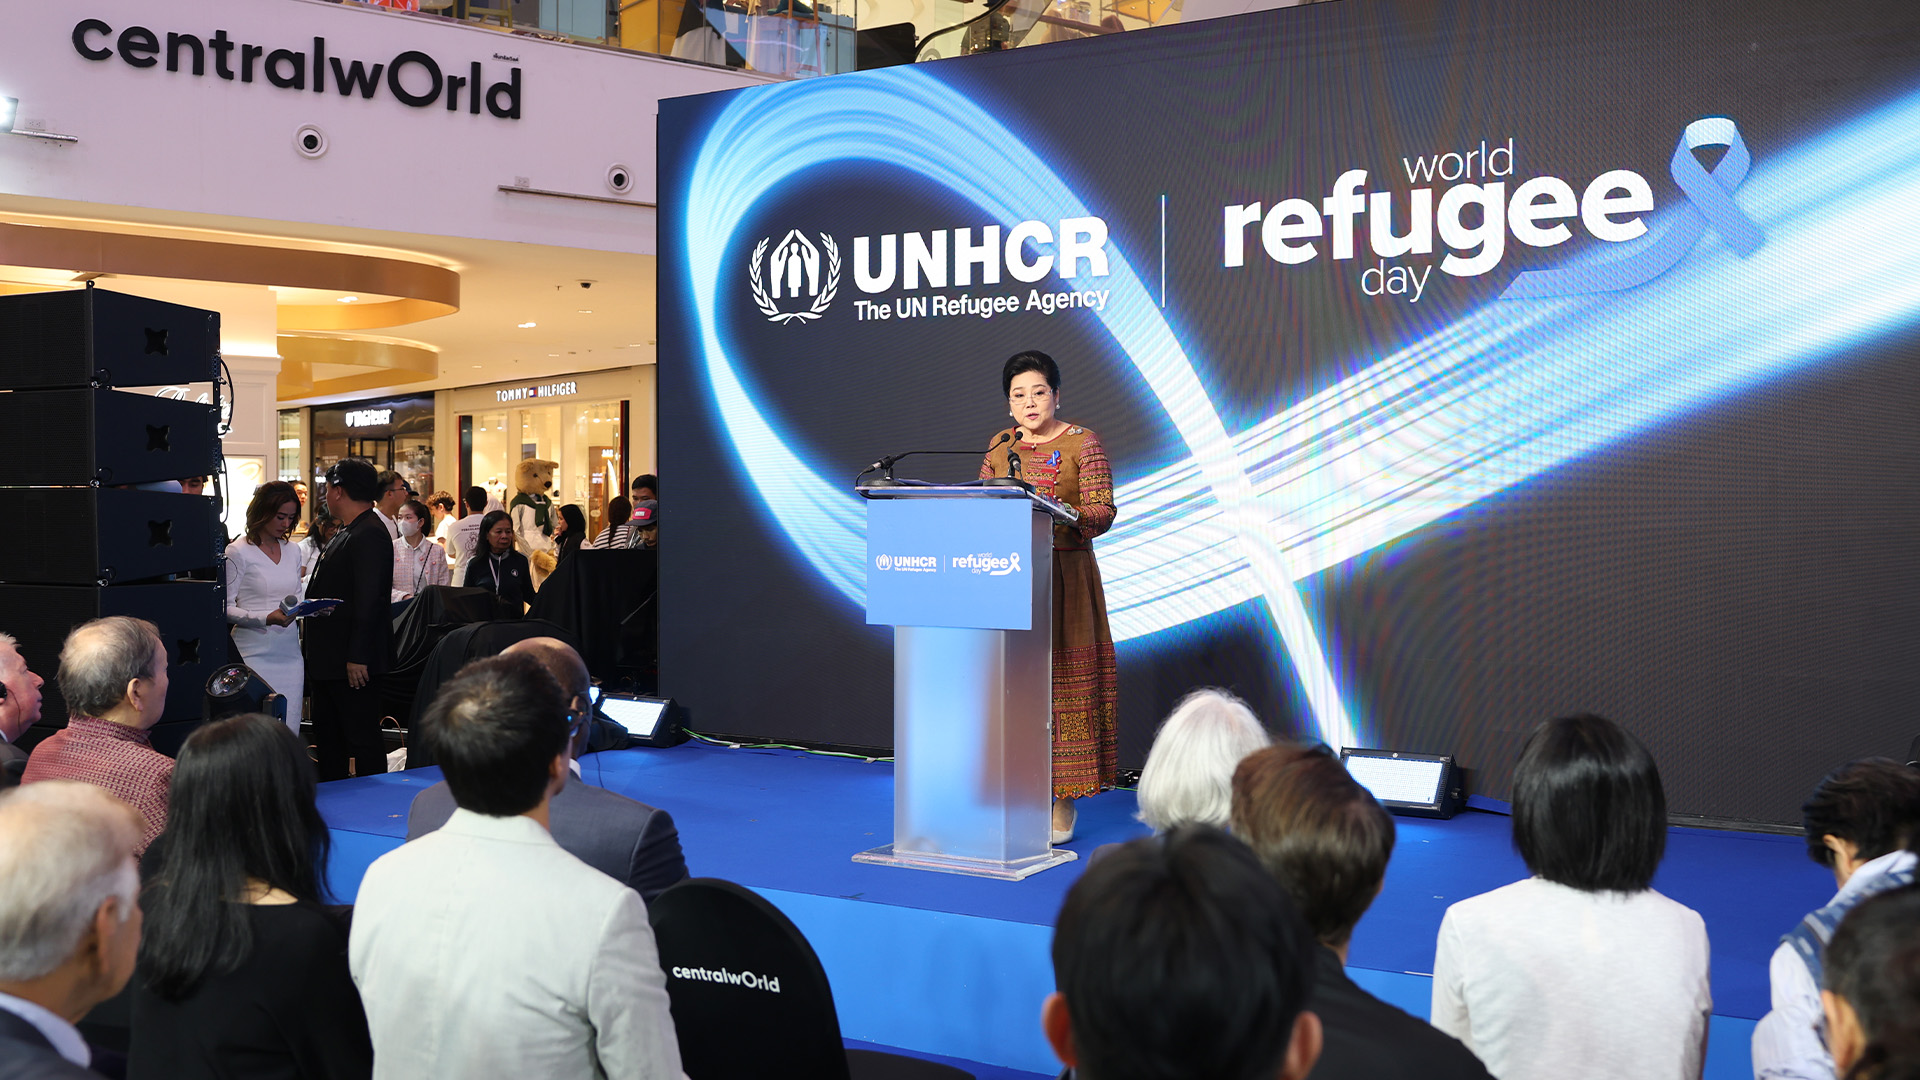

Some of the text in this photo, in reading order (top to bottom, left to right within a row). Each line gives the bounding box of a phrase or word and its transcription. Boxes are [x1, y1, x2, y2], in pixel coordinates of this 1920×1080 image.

[71, 18, 521, 120] centralwOrld
[1403, 137, 1514, 183] world
[1224, 168, 1654, 277] refugee
[853, 216, 1110, 294] UNHCR
[1361, 259, 1432, 303] day
[853, 289, 1110, 321] The UN Refugee Agency
[495, 381, 577, 402] TOMMY HILFIGER
[894, 556, 937, 567] UNHCR
[952, 553, 1009, 572] refugee
[672, 966, 780, 993] centralwOrld
